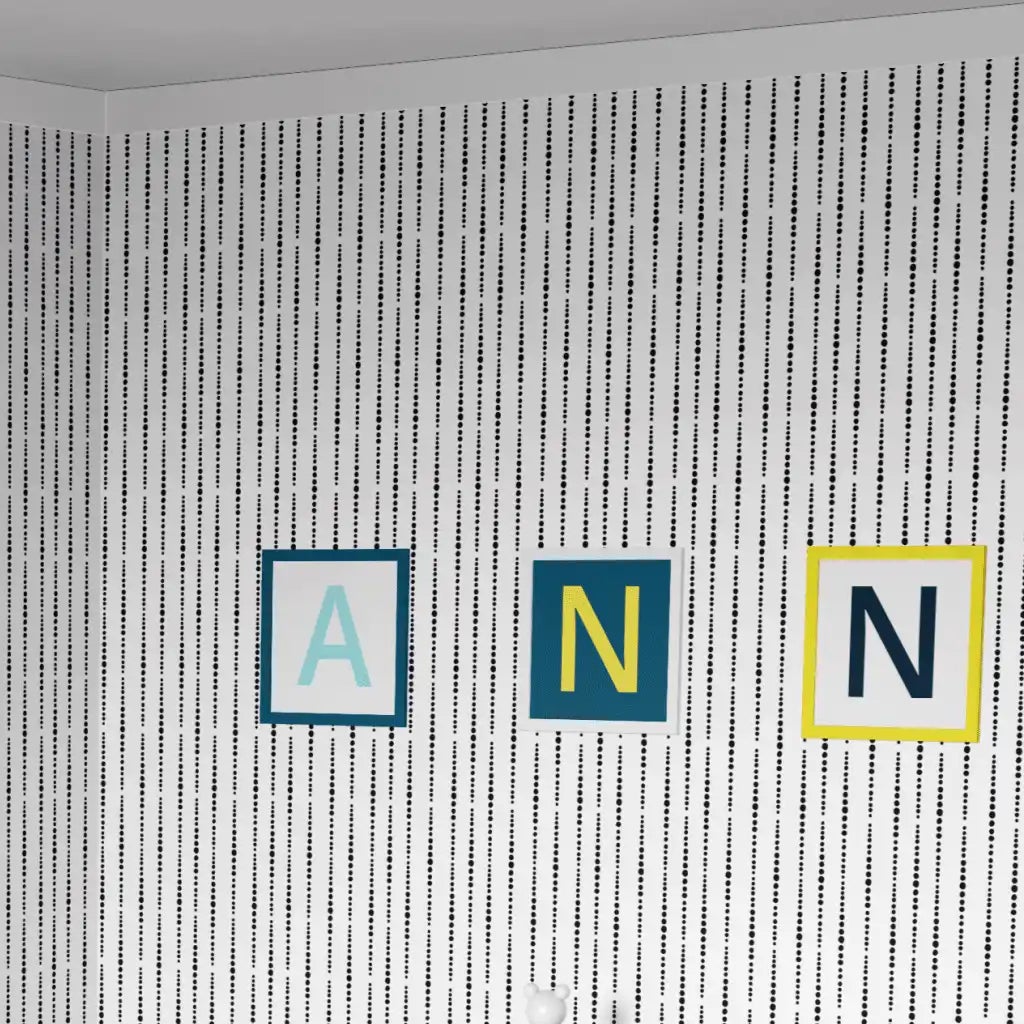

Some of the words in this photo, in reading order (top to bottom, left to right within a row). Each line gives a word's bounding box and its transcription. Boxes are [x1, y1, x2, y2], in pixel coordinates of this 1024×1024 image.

[297, 585, 372, 688] A
[560, 585, 640, 694] N
[847, 585, 937, 699] N
